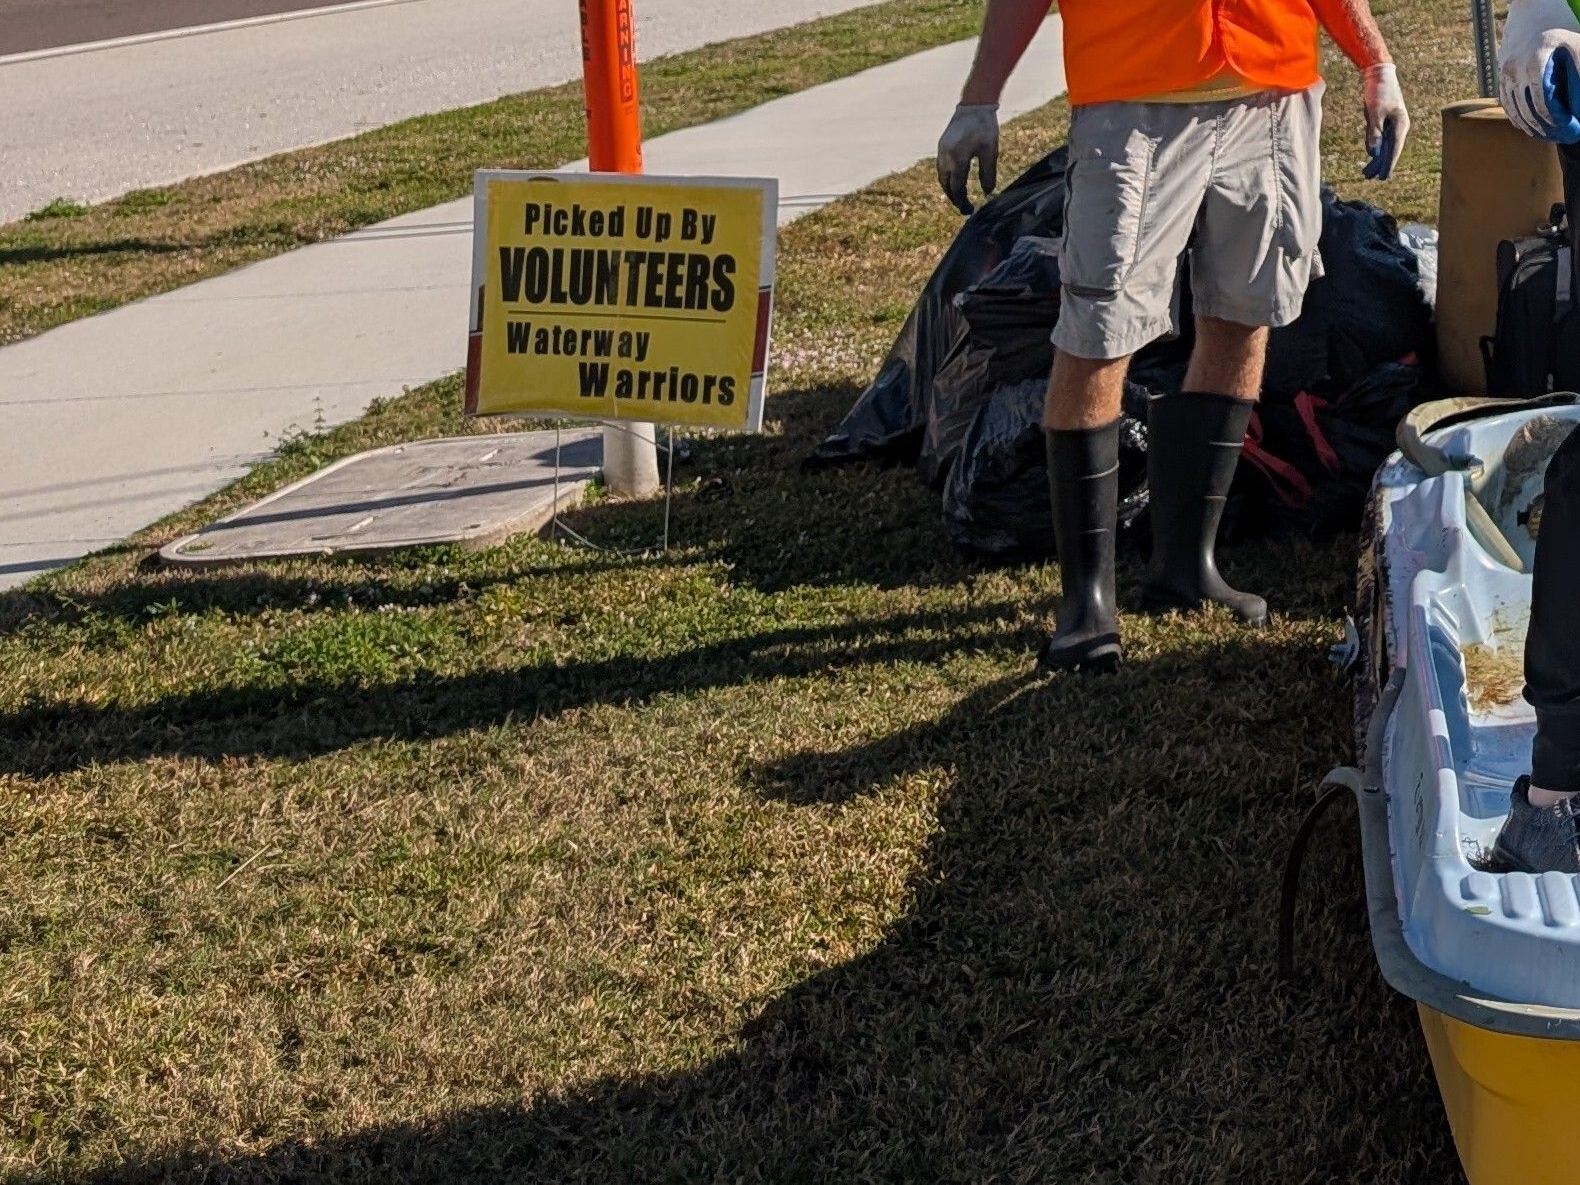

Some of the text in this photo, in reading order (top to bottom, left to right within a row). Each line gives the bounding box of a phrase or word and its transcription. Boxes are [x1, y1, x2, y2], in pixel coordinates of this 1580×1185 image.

[524, 202, 716, 245] Picked Up By
[499, 246, 736, 313] VOLUNTEERS
[507, 321, 650, 363] Waterway
[579, 362, 736, 406] Warriors
